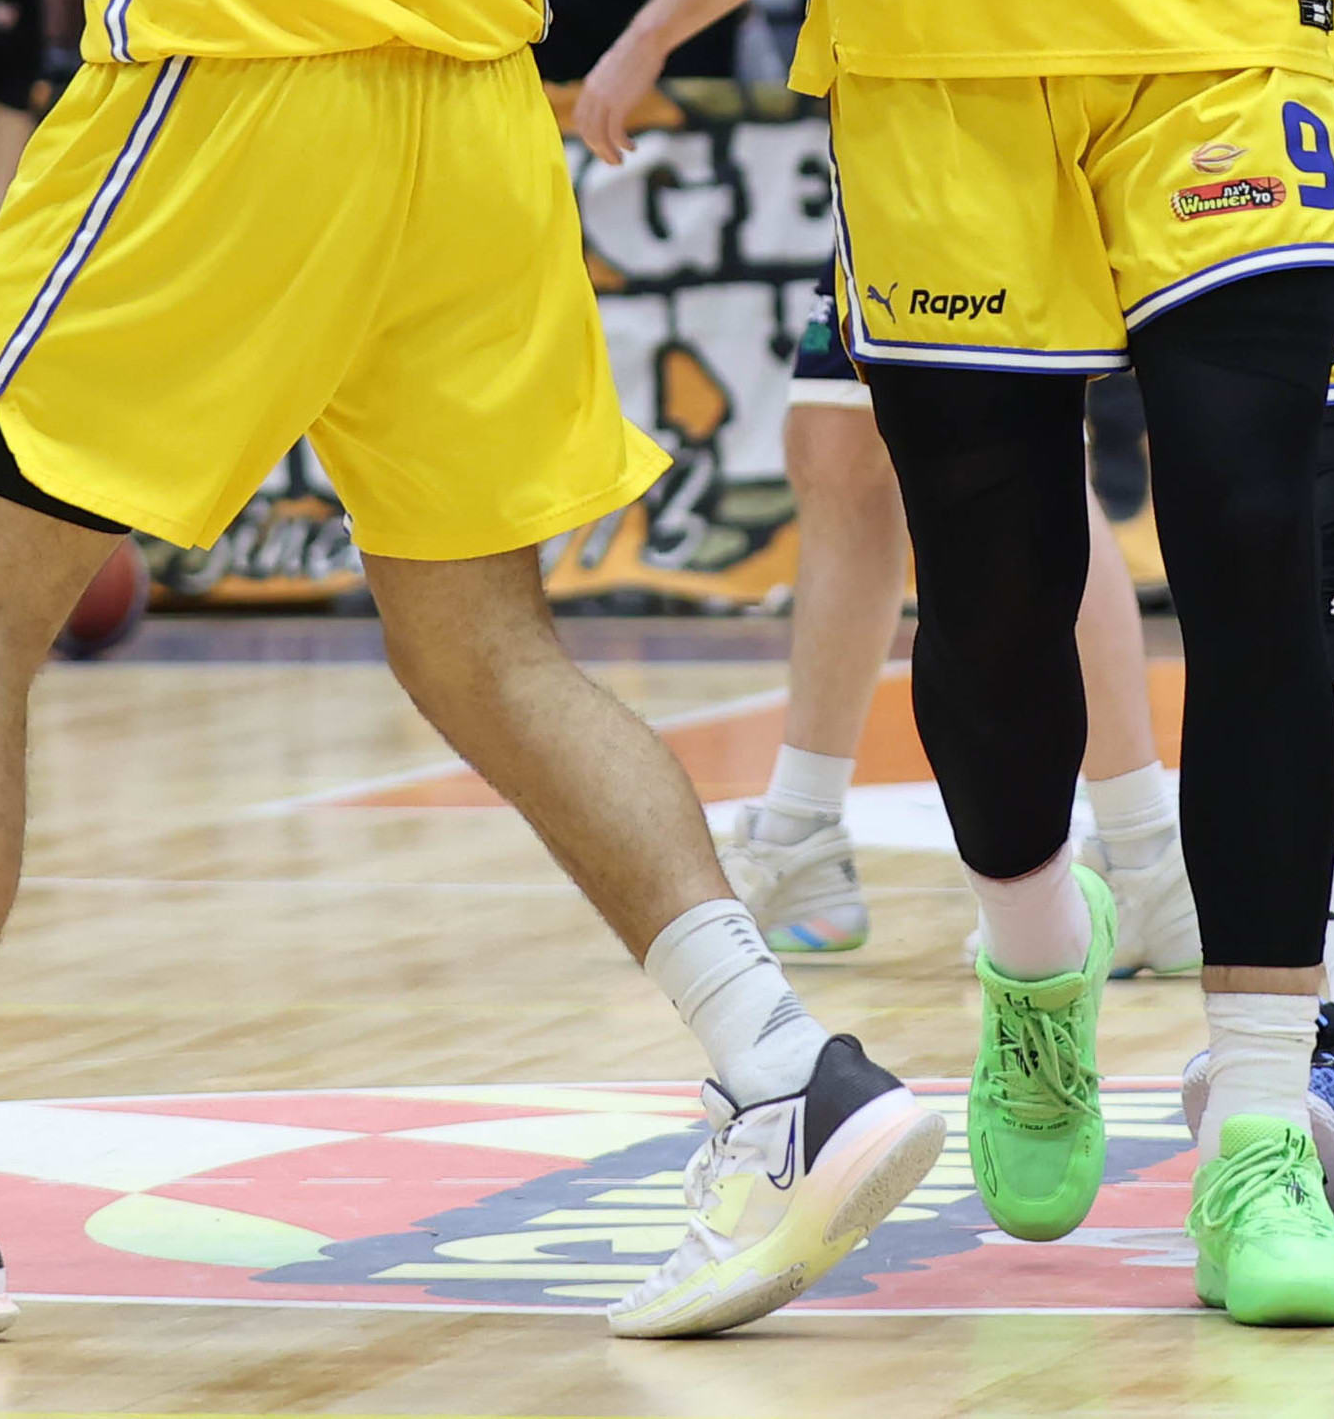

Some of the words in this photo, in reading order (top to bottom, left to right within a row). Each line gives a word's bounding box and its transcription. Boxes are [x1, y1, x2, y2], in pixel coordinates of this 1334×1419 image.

[1223, 182, 1251, 198] ליגת
[1252, 189, 1272, 204] סל
[1178, 194, 1251, 215] Winner
[909, 288, 1007, 321] Rapyd
